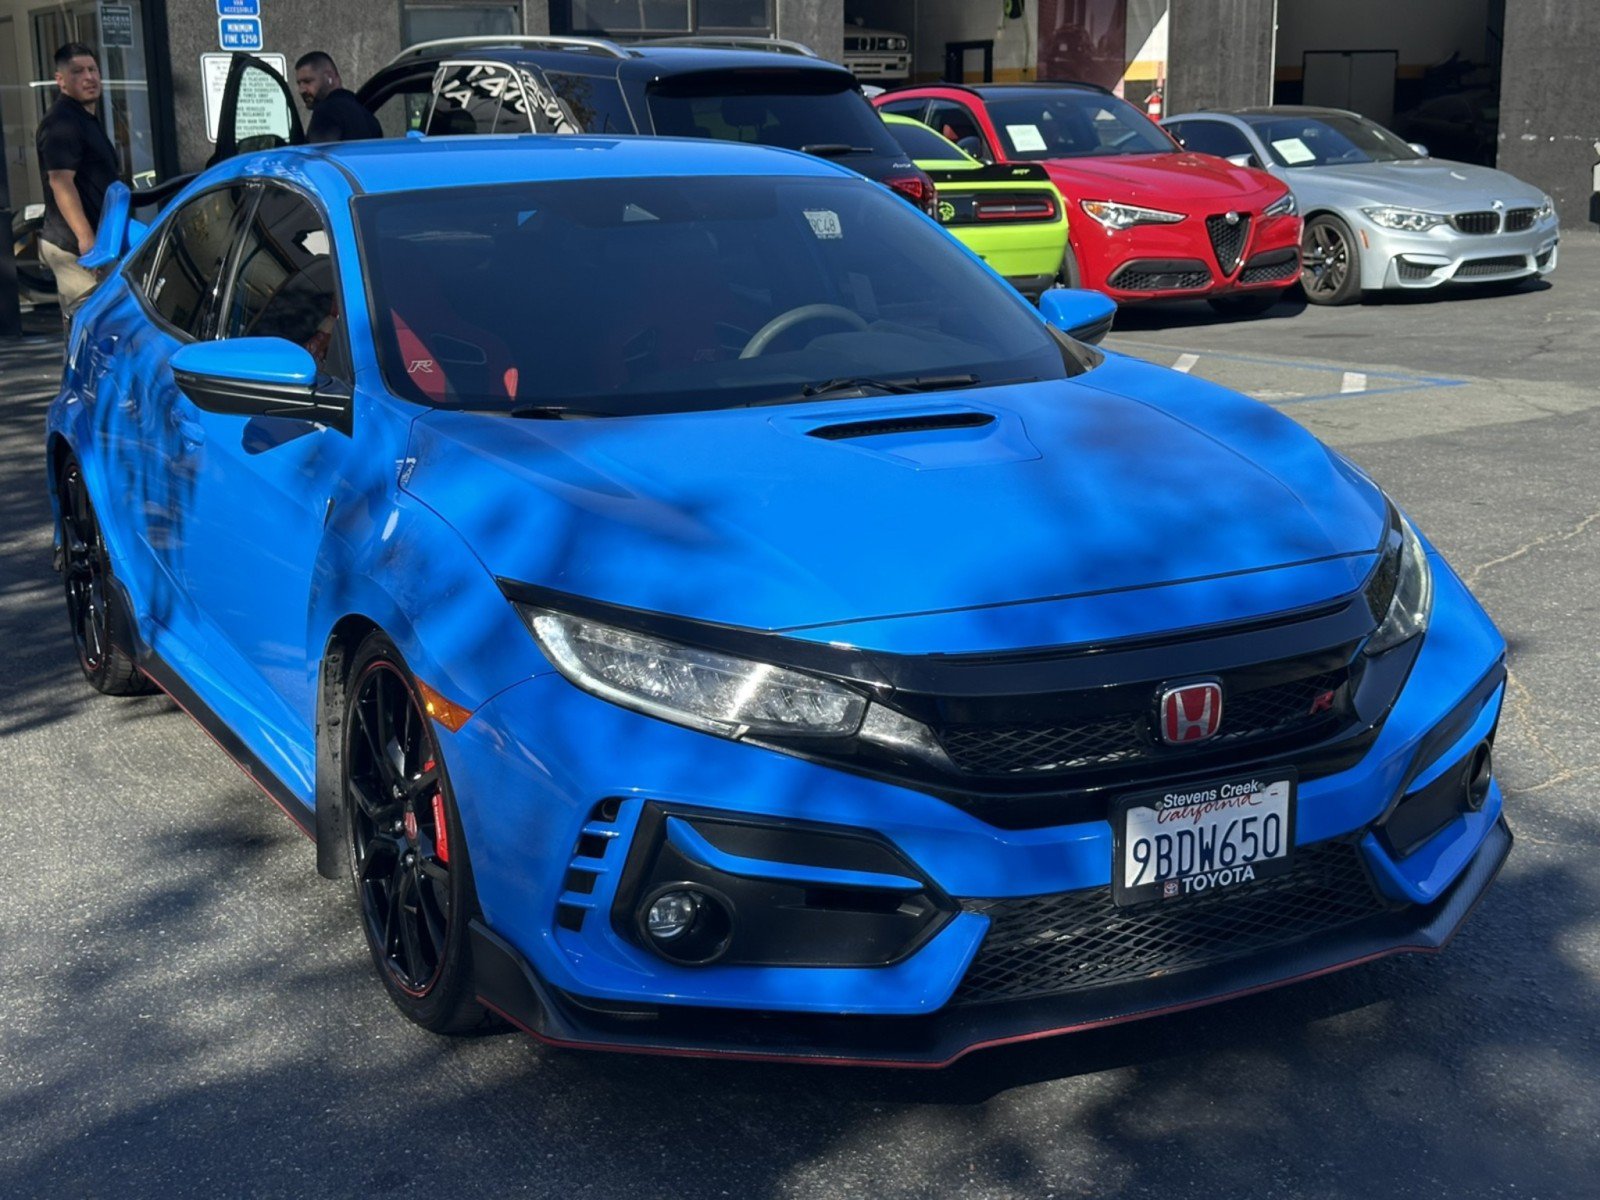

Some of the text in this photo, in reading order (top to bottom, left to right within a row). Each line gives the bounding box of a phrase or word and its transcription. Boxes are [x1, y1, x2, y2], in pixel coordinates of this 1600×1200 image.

[225, 34, 257, 44] FINE $250
[227, 24, 253, 32] MINIMUM
[1158, 794, 1262, 824] California
[1163, 780, 1259, 809] Stevens Creek
[1132, 813, 1280, 887] 9BDW650
[1182, 865, 1255, 894] TOYOTA
